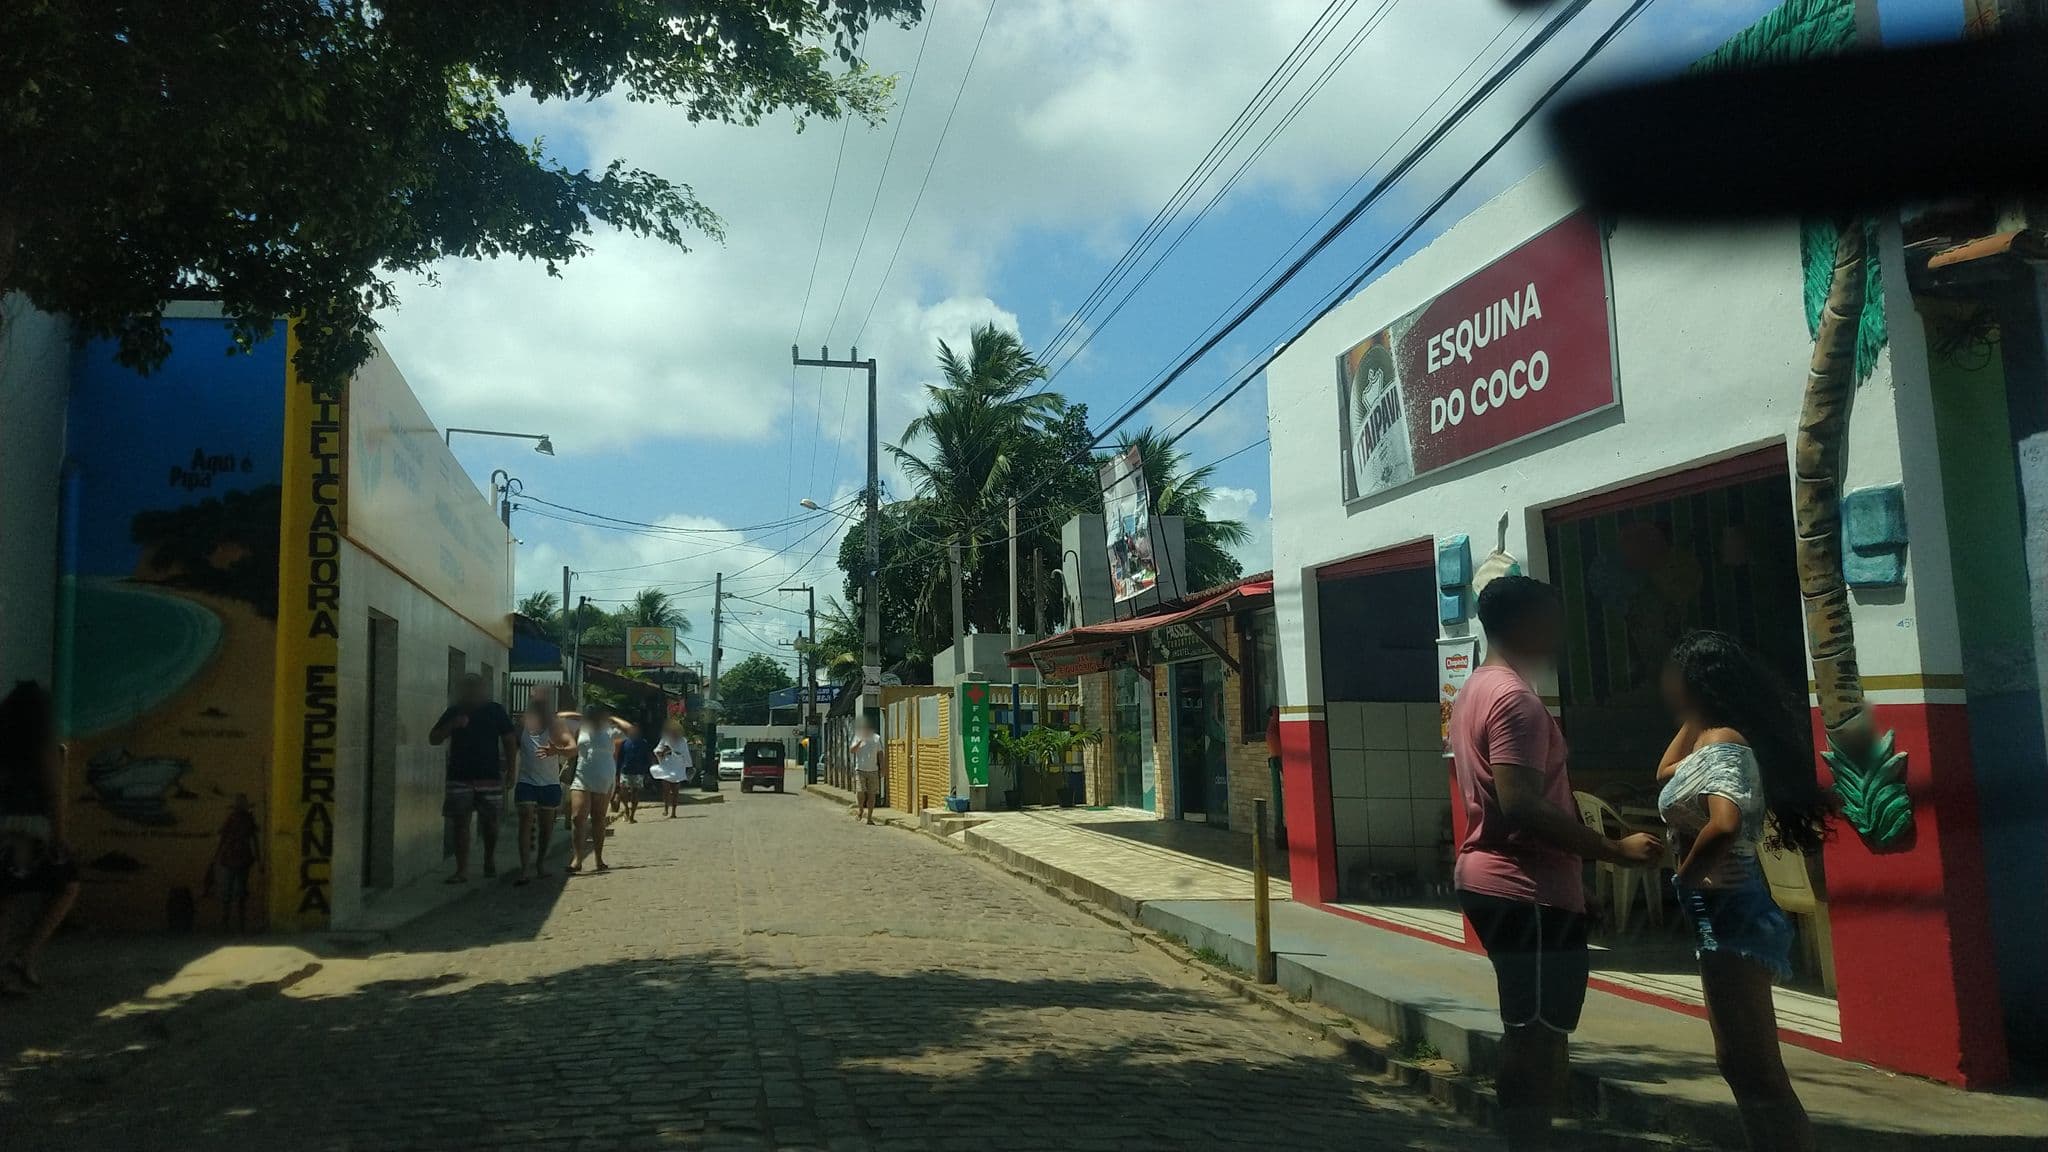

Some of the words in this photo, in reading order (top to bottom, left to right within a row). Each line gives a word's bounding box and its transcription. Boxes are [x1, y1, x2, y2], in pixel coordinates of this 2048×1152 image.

[1427, 281, 1542, 375] ESQUINA
[1430, 387, 1466, 435] DO
[1470, 350, 1550, 417] COCO
